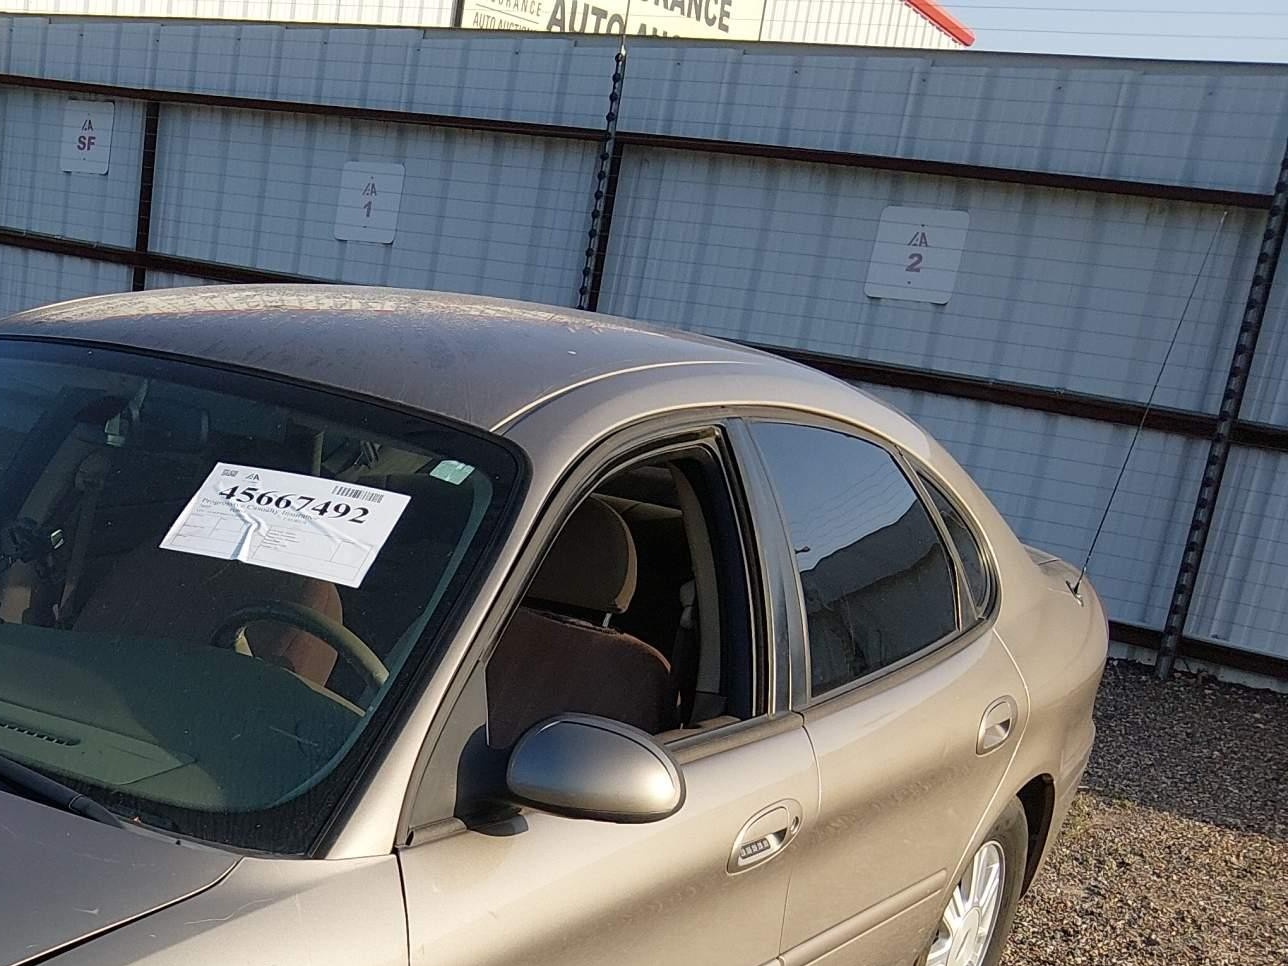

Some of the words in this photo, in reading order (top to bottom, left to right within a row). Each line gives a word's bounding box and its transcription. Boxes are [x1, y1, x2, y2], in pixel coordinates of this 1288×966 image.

[77, 135, 96, 151] SF
[363, 201, 372, 218] 1
[905, 253, 923, 272] 2
[219, 485, 370, 524] 45667492
